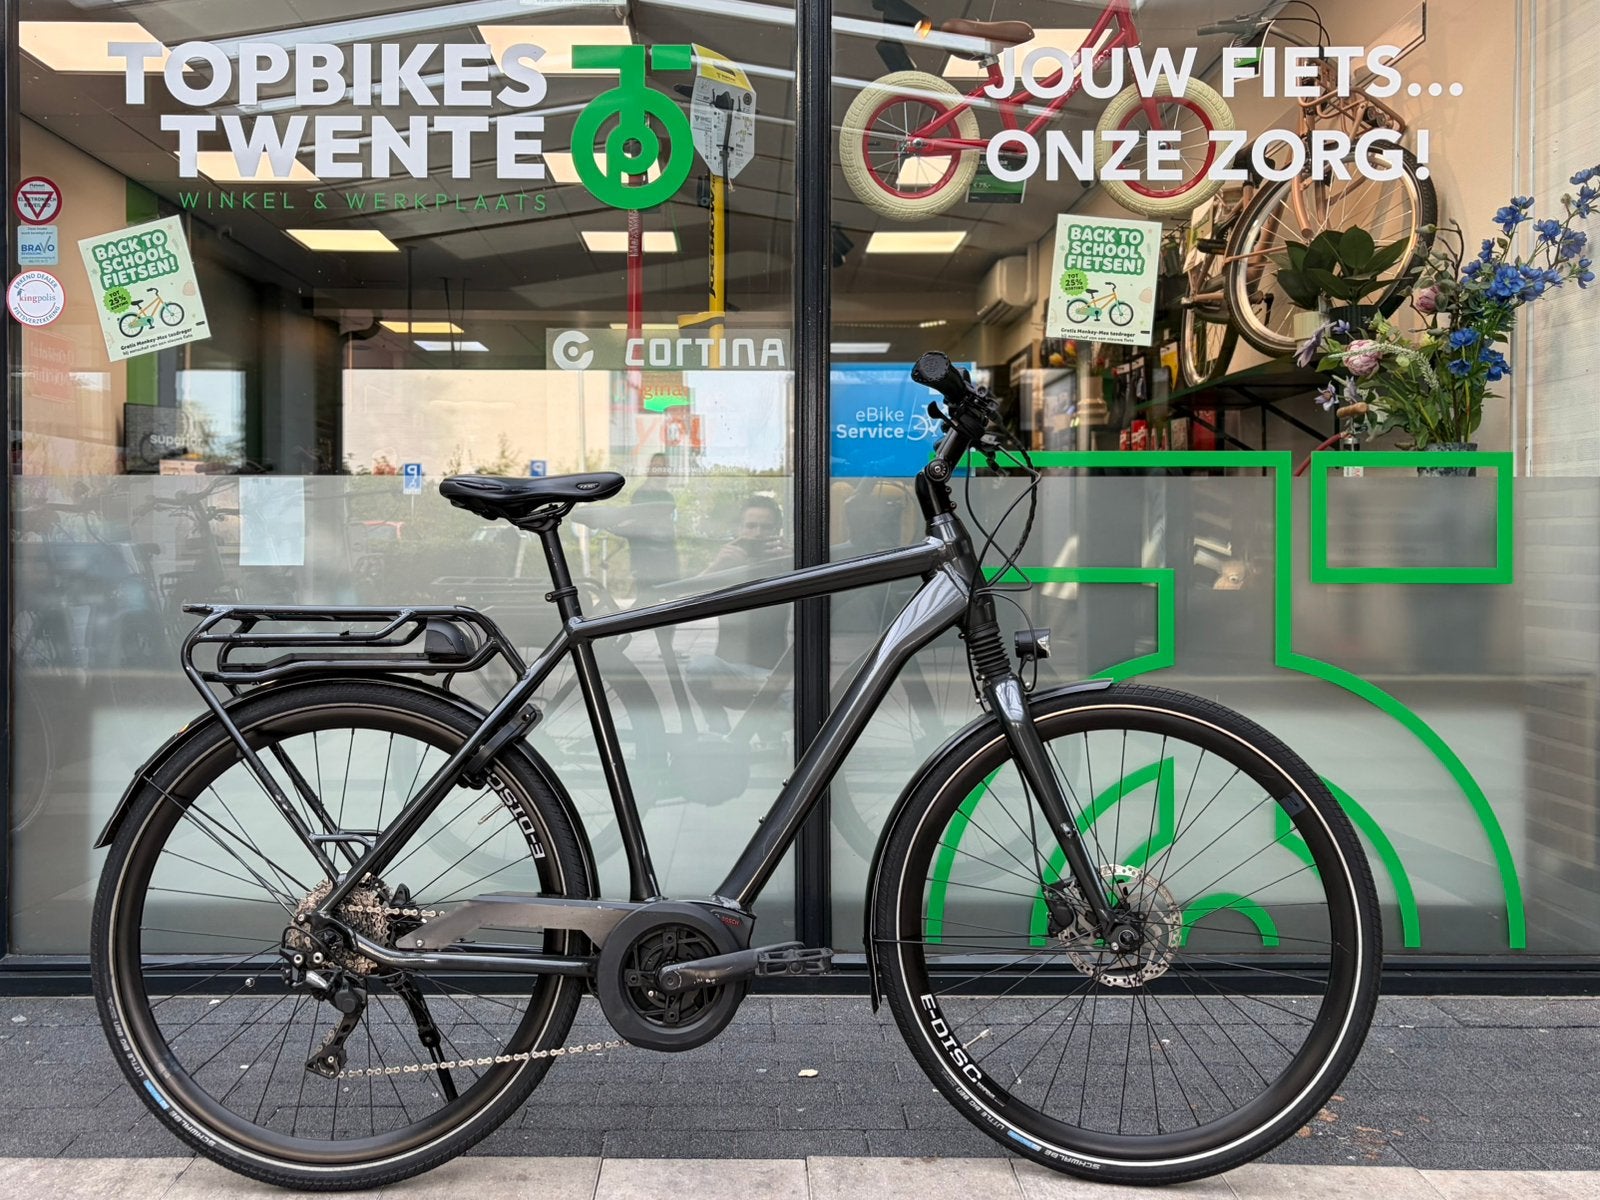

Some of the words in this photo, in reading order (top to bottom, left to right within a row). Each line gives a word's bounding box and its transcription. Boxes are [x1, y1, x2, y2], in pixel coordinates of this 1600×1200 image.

[108, 41, 548, 107] TOPBIKES
[984, 46, 1199, 99] JOUW
[1222, 45, 1465, 99] FIETS...
[161, 115, 546, 180] TWENTE
[985, 128, 1182, 183] ONZE
[1208, 128, 1431, 183] ZORG!
[179, 190, 295, 210] WINKEL
[313, 193, 328, 210] &
[345, 191, 549, 213] WERKPLAATS
[94, 238, 142, 260] BACK
[141, 231, 165, 248] TO
[1070, 227, 1115, 243] BACK
[1118, 230, 1141, 245] TO
[101, 245, 169, 274] SCHOOL
[1070, 241, 1139, 258] SCHOOL
[102, 256, 177, 288] FIETSEN!
[1066, 254, 1143, 273] FIETSEN!
[14, 272, 36, 290] ERKEND
[36, 272, 58, 289] DEALER
[1065, 278, 1083, 287] 25%
[18, 292, 57, 304] kingpolis
[108, 293, 127, 306] 25%
[109, 290, 120, 298] TOT
[13, 305, 61, 324] FIETSVERZEKERING
[855, 407, 905, 422] eBike
[836, 424, 905, 439] Service
[486, 773, 546, 859] E-DISC
[920, 993, 982, 1084] E-DISC
[168, 1110, 217, 1148] SCHWALBE
[980, 1110, 1005, 1130] LITTLE
[1043, 1148, 1102, 1171] SCHWALBE
